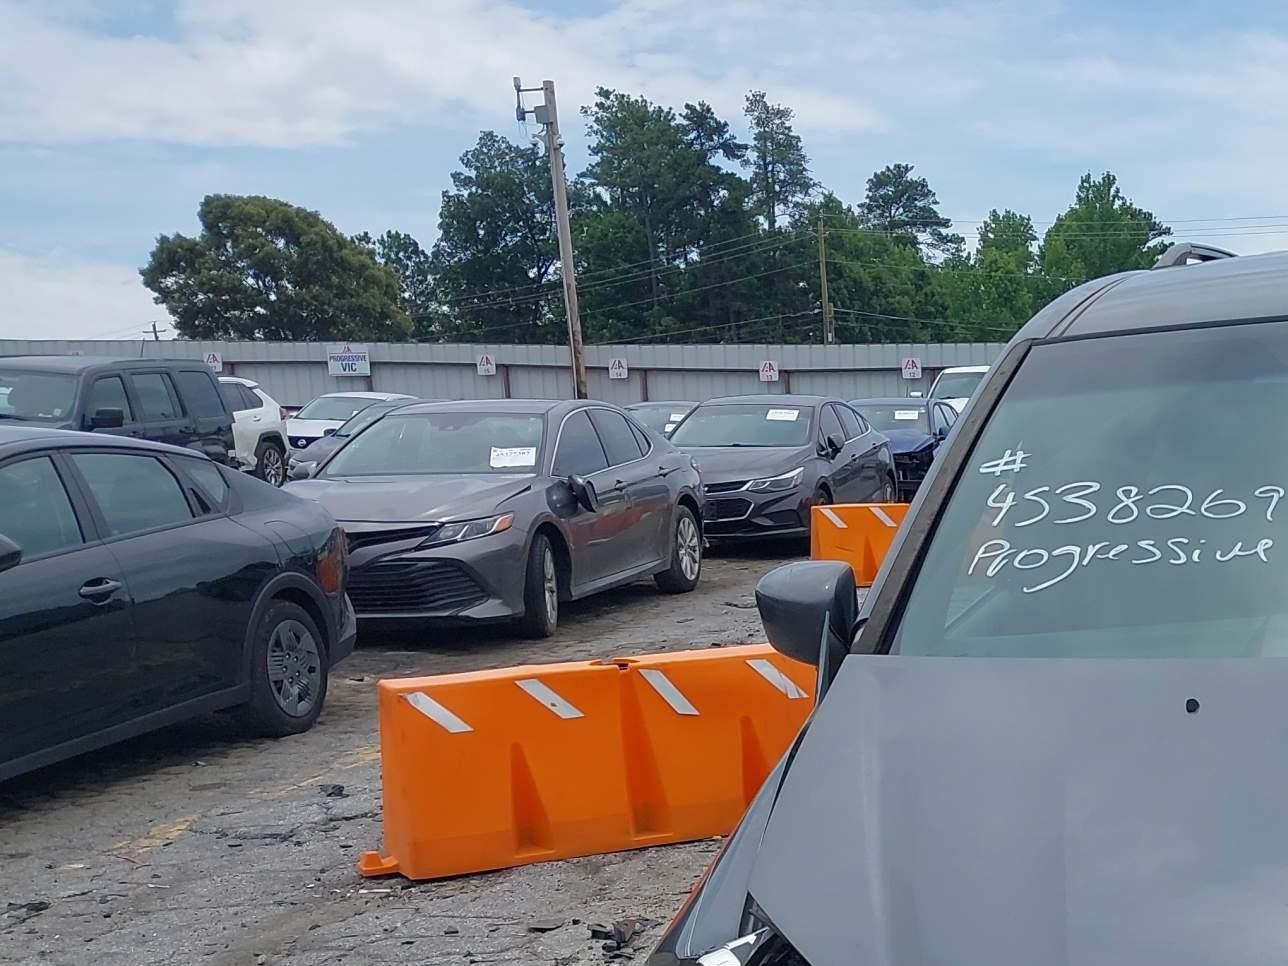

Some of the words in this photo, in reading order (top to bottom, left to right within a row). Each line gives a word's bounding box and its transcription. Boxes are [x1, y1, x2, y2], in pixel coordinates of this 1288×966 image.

[341, 362, 357, 372] VIC
[979, 449, 1031, 476] #
[968, 537, 1273, 593] Progressive
